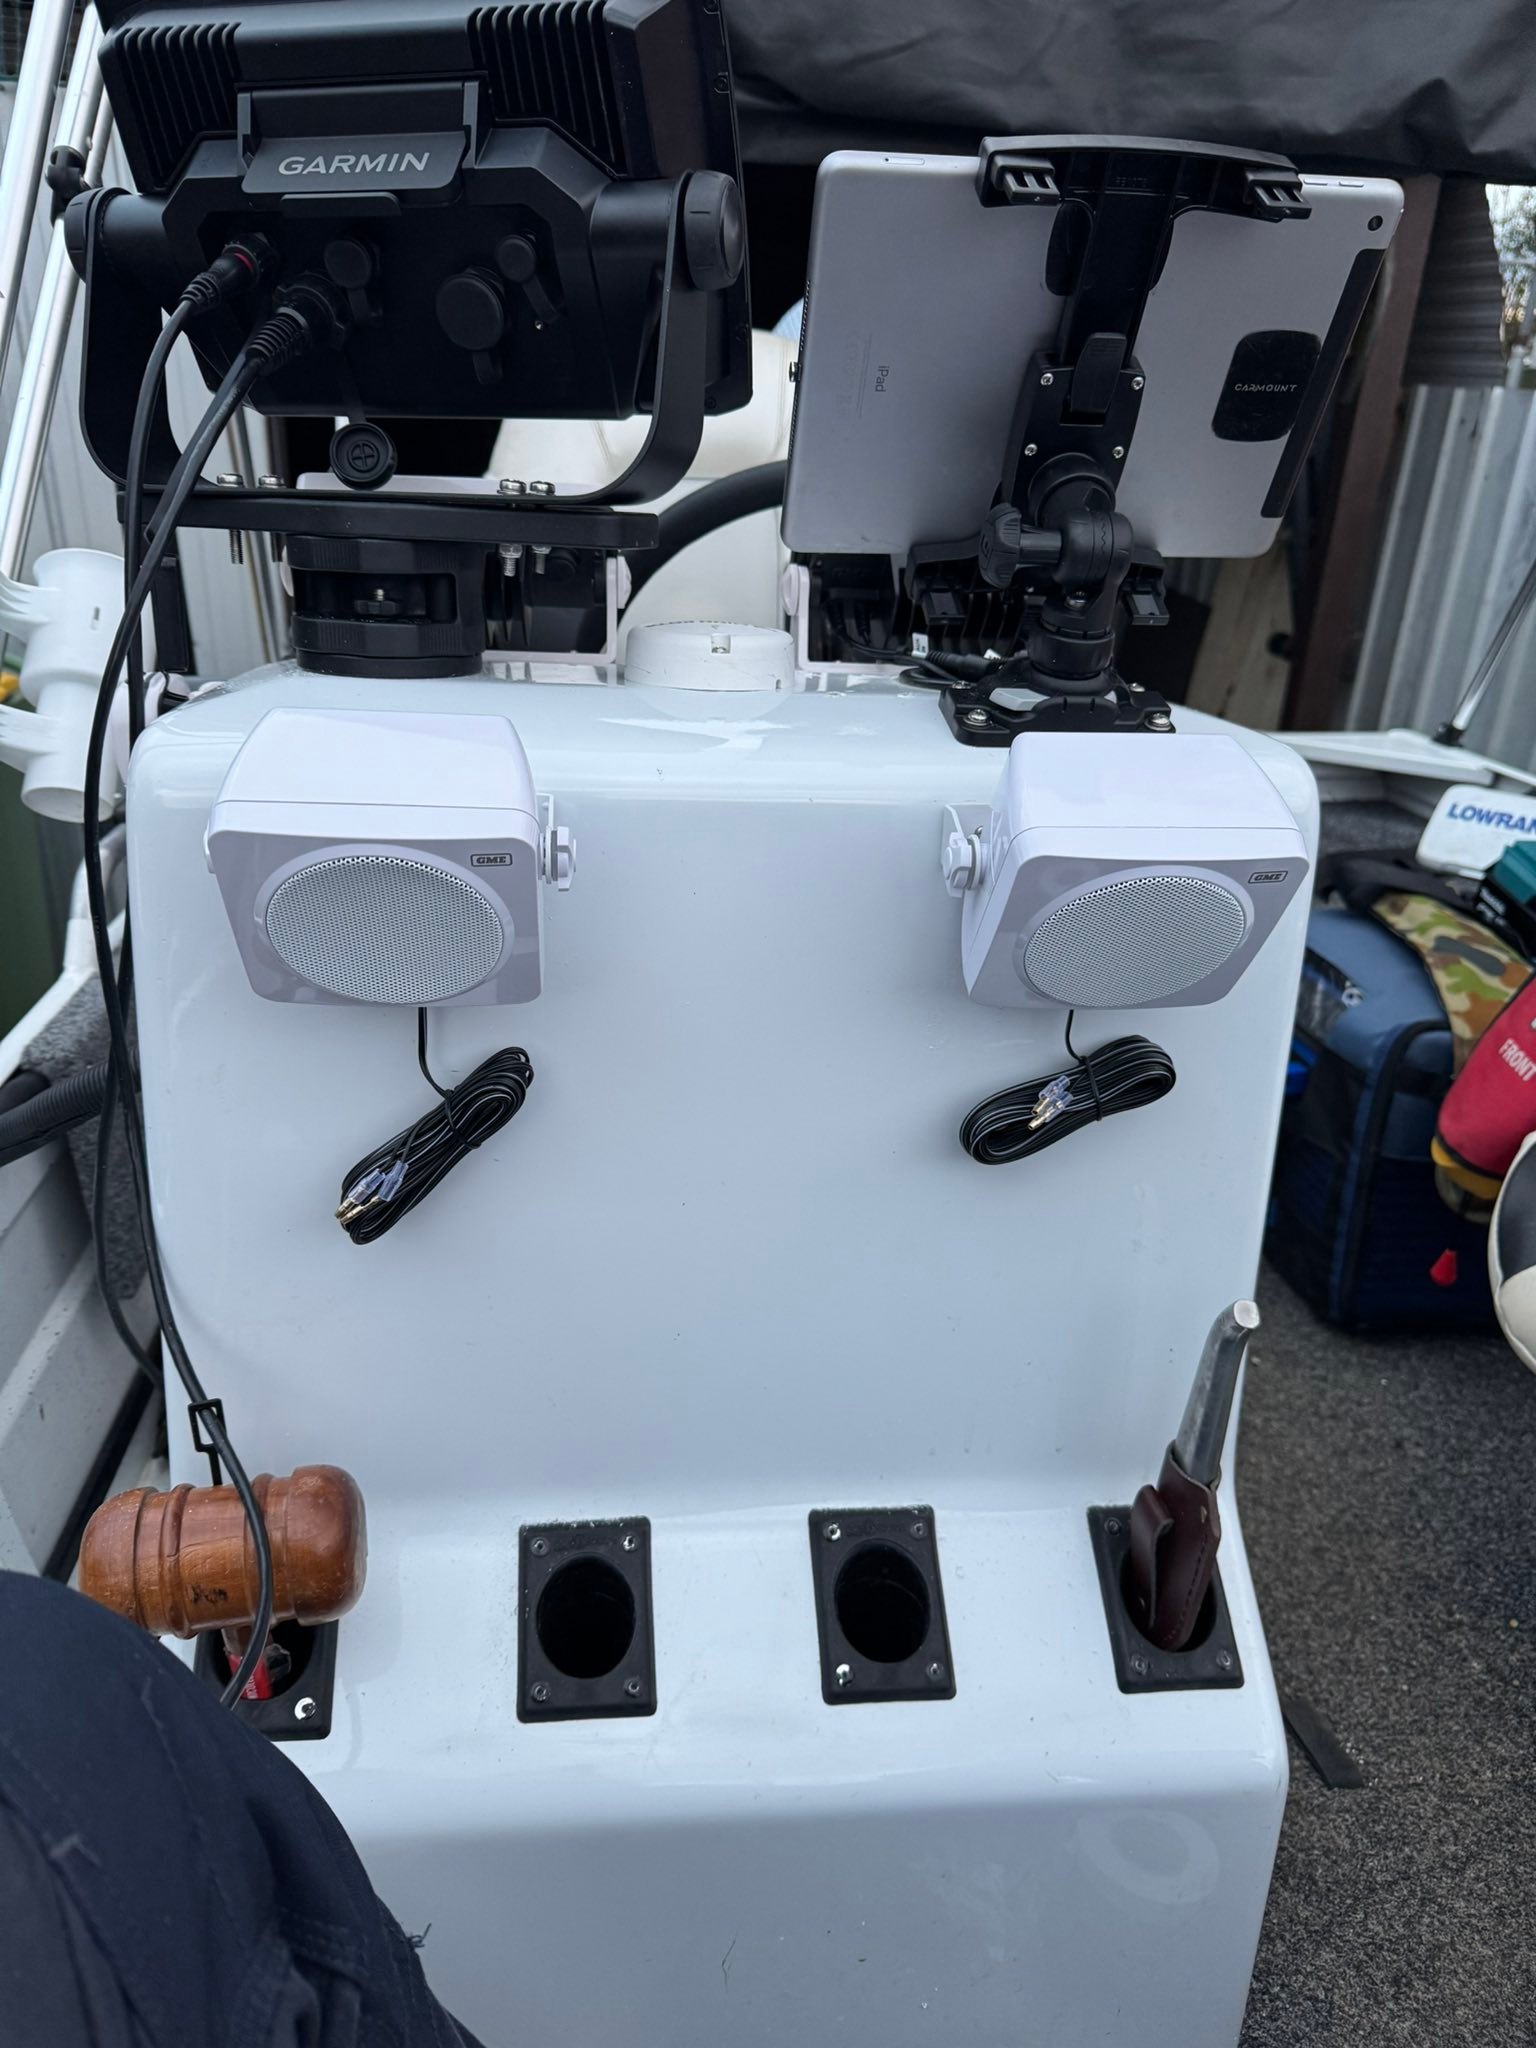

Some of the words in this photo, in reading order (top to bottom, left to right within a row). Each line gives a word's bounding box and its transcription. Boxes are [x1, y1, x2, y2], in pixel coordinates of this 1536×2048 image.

[278, 152, 430, 175] GARMIN
[874, 365, 890, 392] iPad
[1234, 383, 1298, 392] CARMOUNT
[475, 855, 507, 865] GME
[1253, 872, 1283, 881] GME
[1498, 1038, 1536, 1081] FRONT
